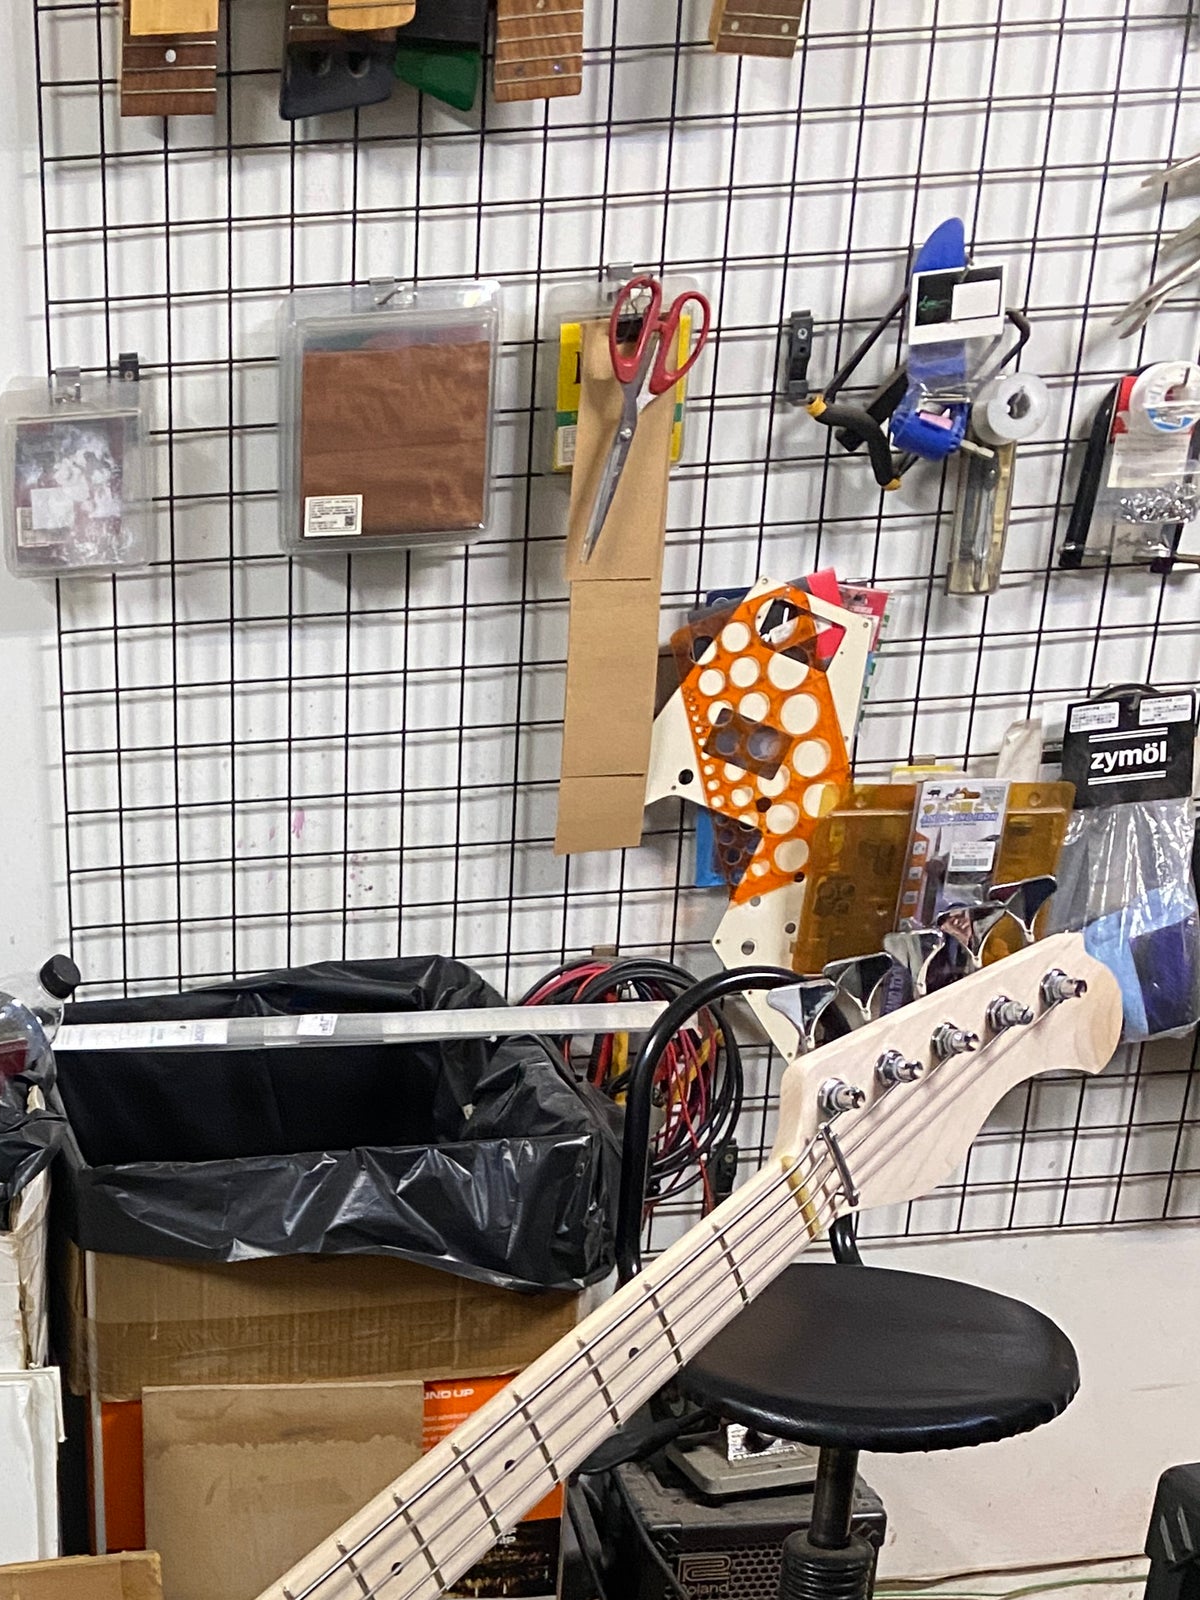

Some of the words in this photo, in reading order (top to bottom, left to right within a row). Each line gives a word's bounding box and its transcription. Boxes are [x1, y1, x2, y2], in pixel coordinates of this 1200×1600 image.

[1090, 740, 1168, 774] zymöl
[453, 1388, 475, 1398] UP
[682, 1582, 730, 1596] oland
